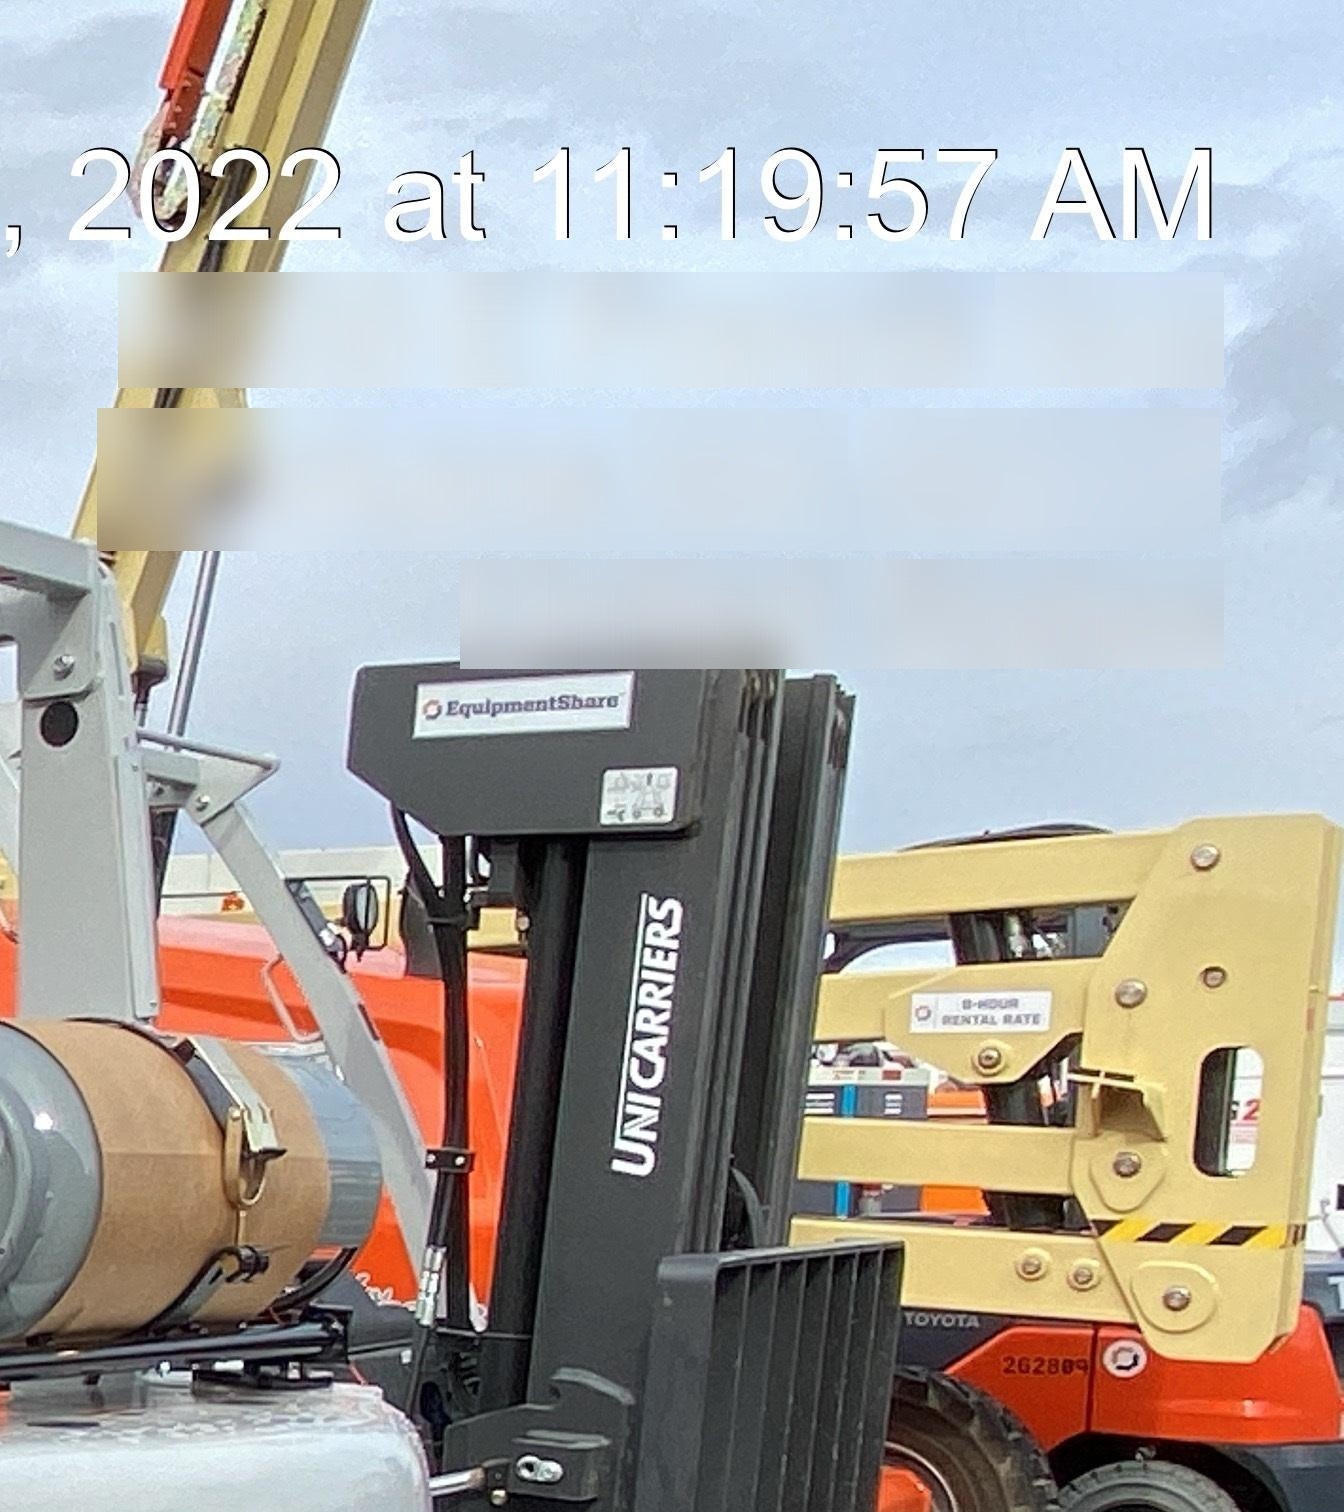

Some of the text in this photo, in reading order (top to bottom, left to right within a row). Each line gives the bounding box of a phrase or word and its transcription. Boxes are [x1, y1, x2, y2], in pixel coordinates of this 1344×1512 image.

[446, 693, 619, 718] EquipmentShare
[942, 1014, 1041, 1026] RENTAL RATE
[611, 893, 683, 1177] UNICARRIERS
[904, 1312, 980, 1328] TOYOTA
